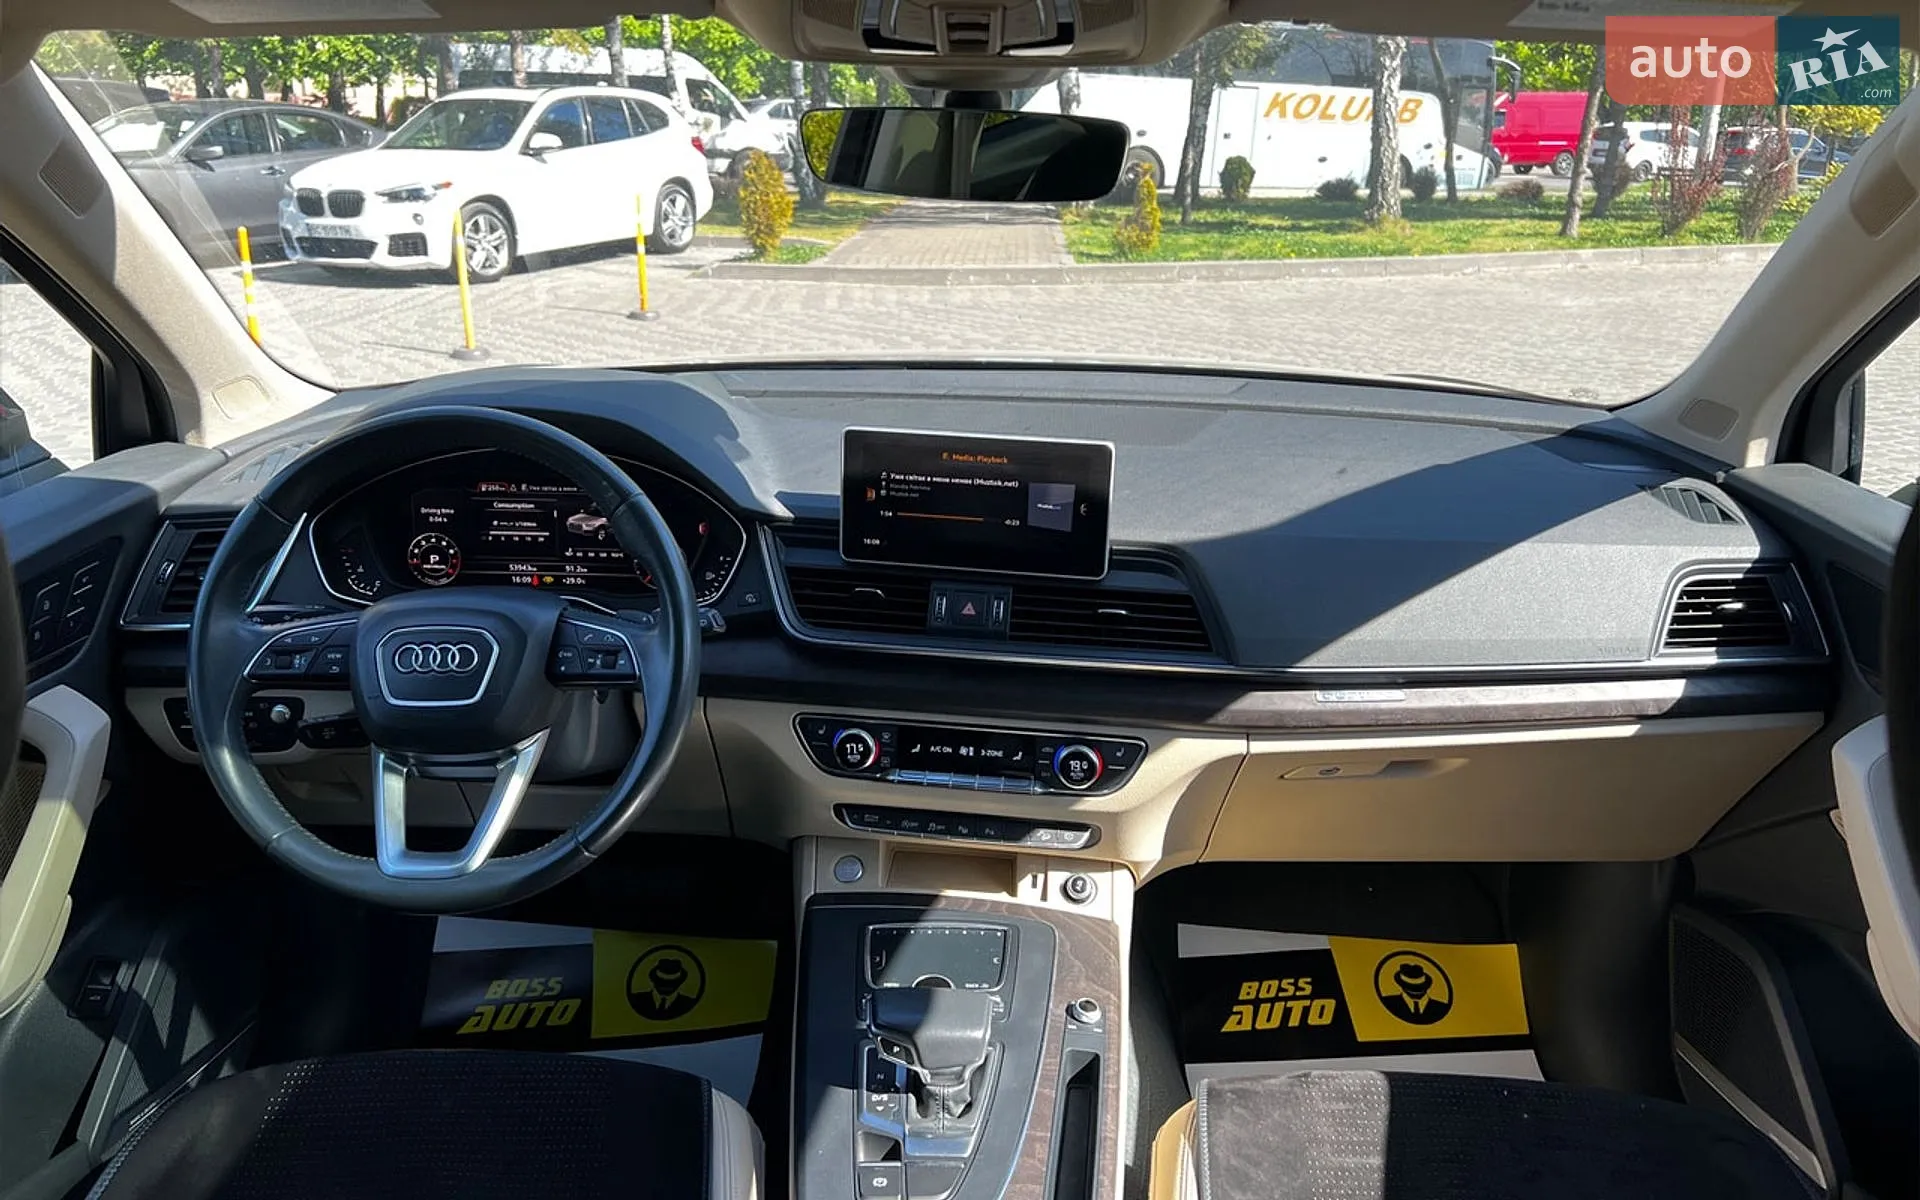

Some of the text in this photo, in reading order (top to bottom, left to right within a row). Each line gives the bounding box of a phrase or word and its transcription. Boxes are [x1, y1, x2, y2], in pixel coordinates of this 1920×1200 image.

[1263, 92, 1423, 123] KOLUB
[493, 501, 535, 511] Consumption
[484, 977, 564, 1000] BOSS
[1238, 977, 1313, 1000] BOSS
[456, 999, 582, 1035] AUTO
[1220, 999, 1337, 1033] AUTO
